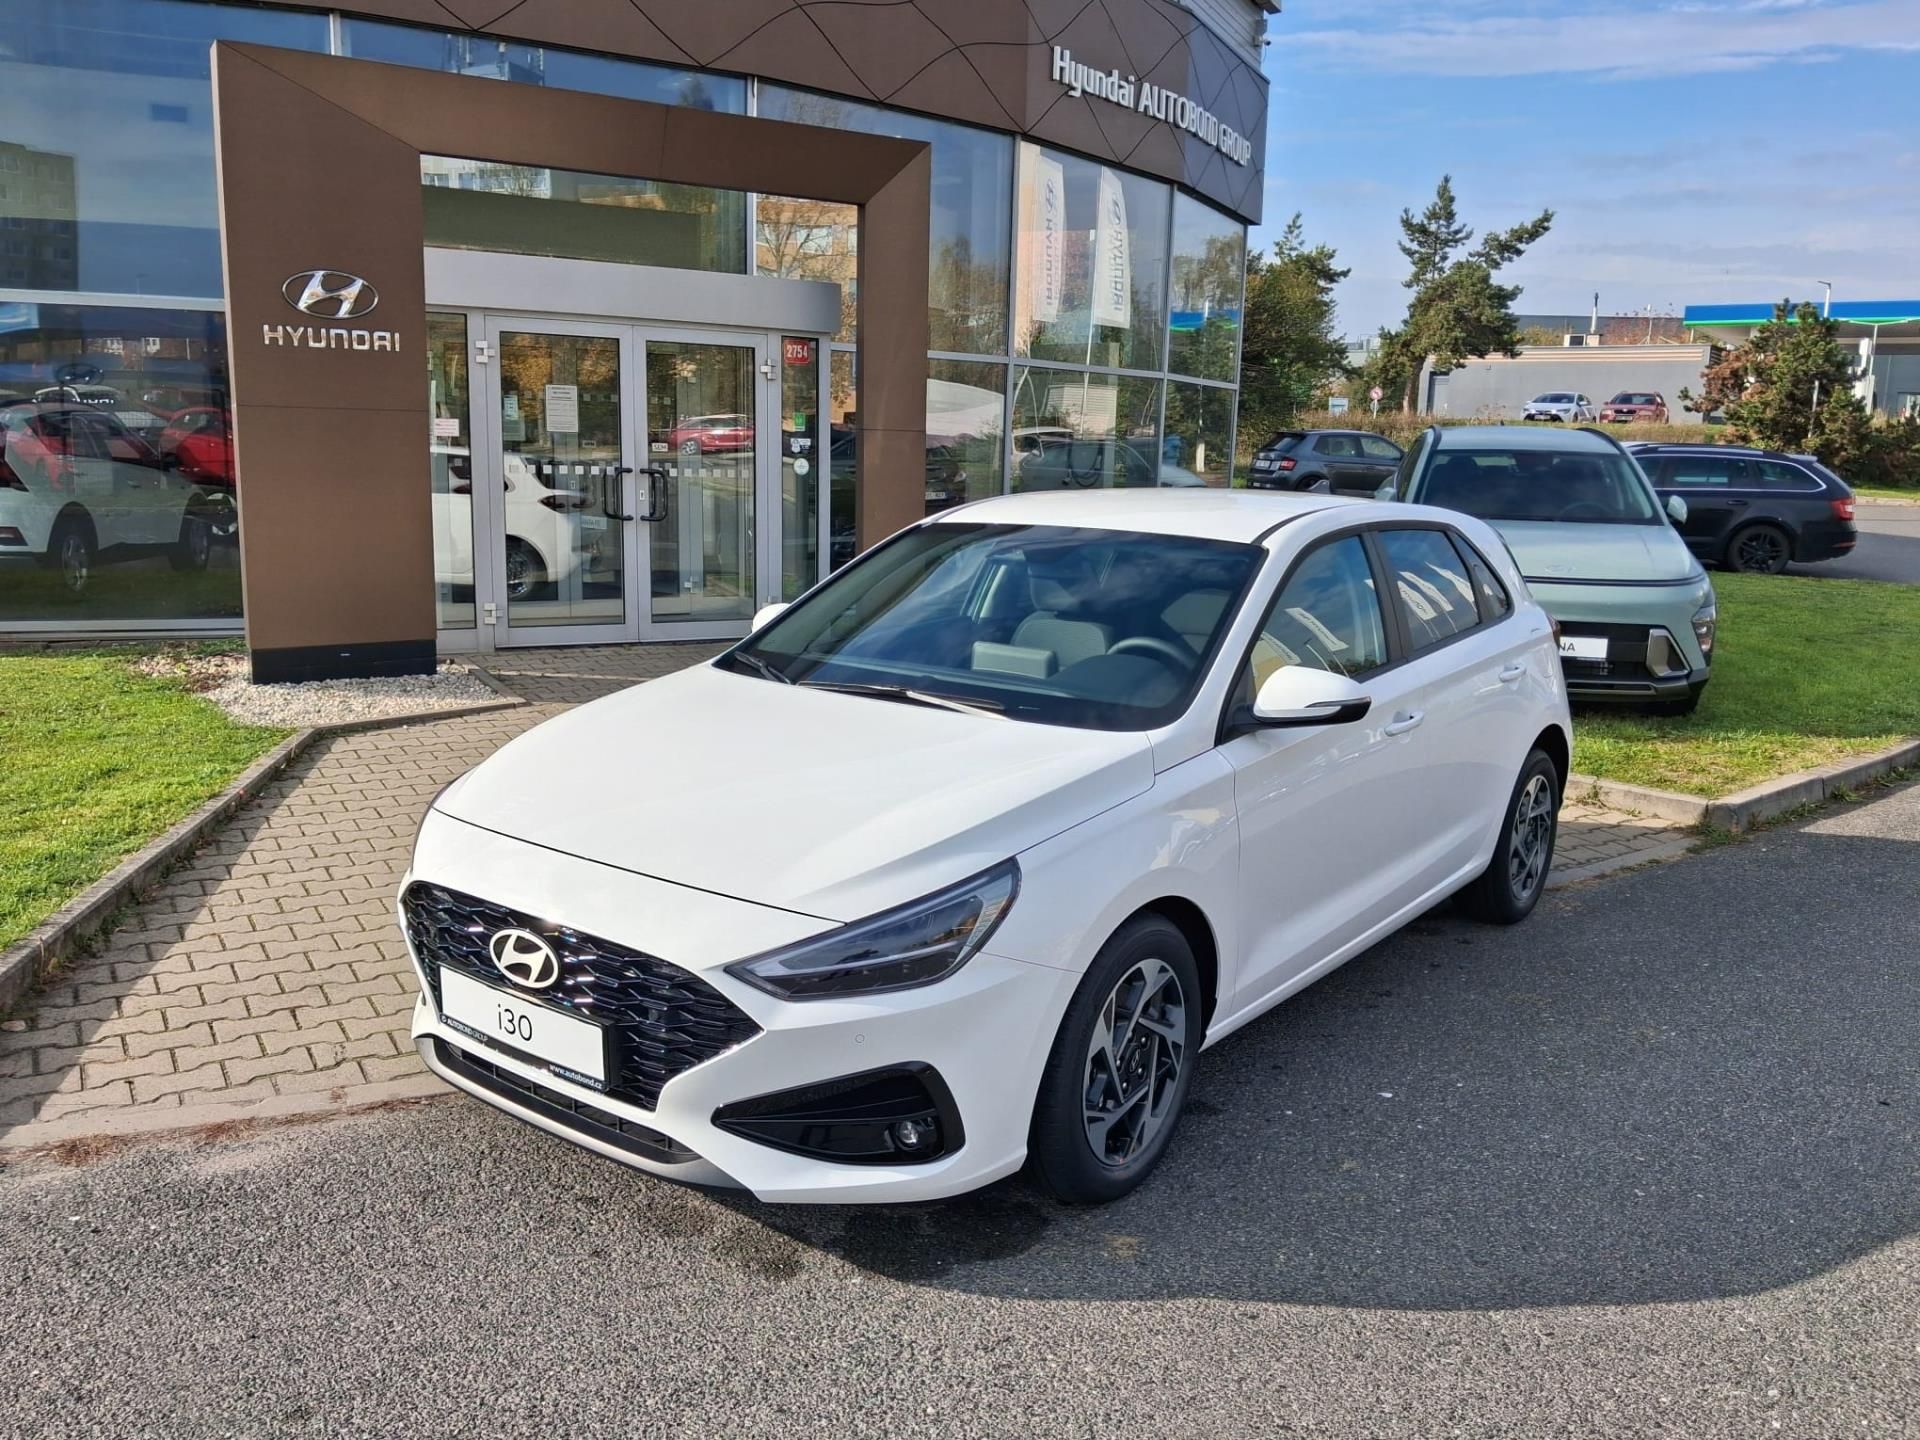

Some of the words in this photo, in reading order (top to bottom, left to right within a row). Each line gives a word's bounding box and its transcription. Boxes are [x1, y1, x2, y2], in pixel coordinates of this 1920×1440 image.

[1053, 45, 1135, 109] Hyundai
[1137, 82, 1219, 147] AUTOBOND
[1219, 123, 1251, 167] GROUP
[263, 324, 400, 352] HYUNDAI
[786, 344, 808, 359] 2754
[1559, 642, 1576, 652] NA
[497, 1003, 533, 1041] i30
[549, 1063, 603, 1090] www.autobond.cz
